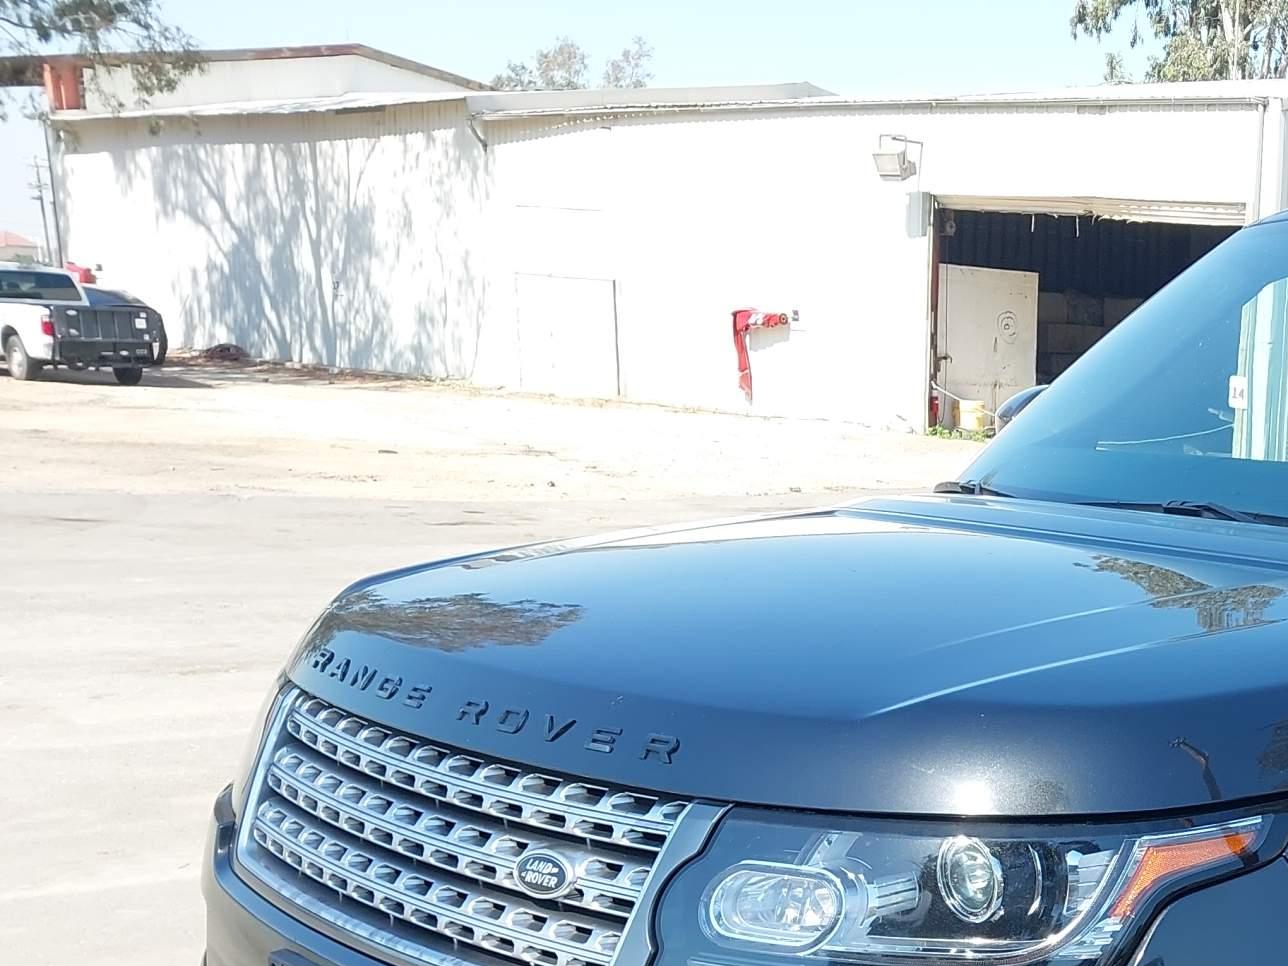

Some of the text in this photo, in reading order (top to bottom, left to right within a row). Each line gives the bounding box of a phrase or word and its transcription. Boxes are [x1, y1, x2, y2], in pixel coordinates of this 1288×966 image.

[1232, 387, 1244, 400] 14
[310, 648, 681, 764] RANGE ROVER
[526, 858, 553, 874] LAND
[525, 870, 558, 888] ROVER
